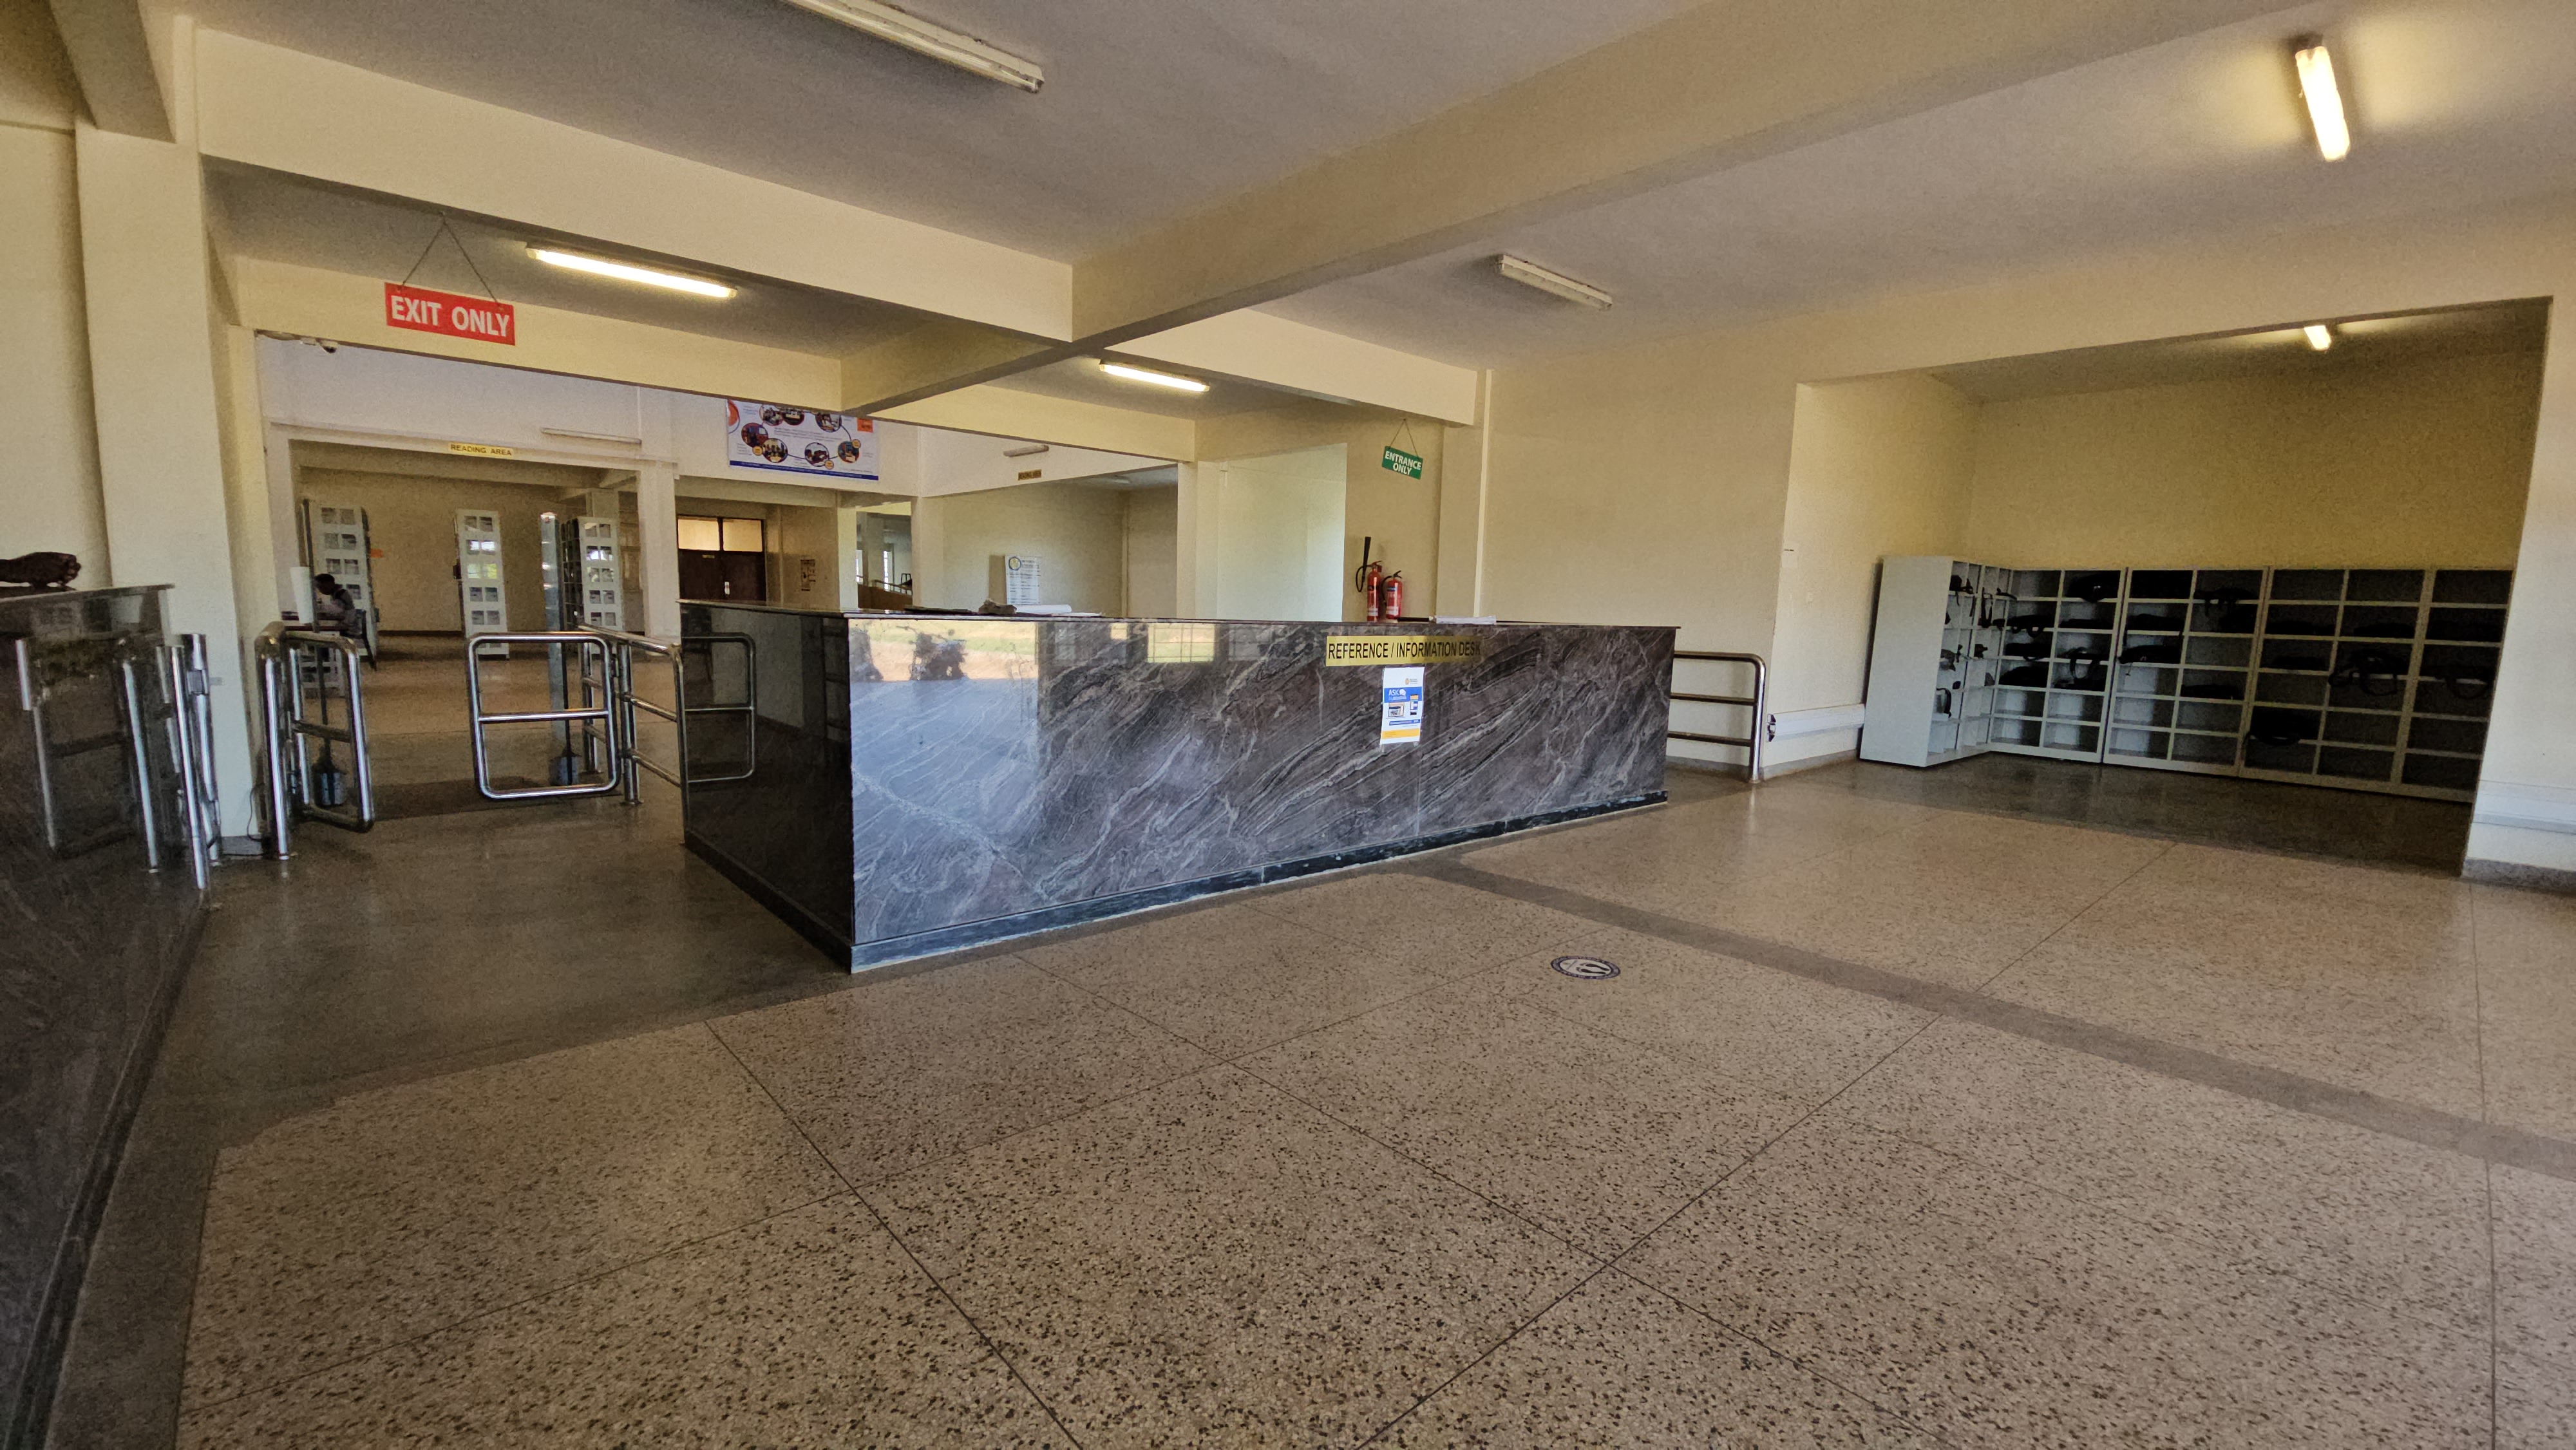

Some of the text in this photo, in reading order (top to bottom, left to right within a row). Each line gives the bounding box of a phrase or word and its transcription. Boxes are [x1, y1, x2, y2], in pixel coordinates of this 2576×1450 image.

[391, 295, 509, 337] EXIT ONLY
[450, 444, 512, 456] READING AREA
[1385, 450, 1422, 470] ENTRANCE
[1392, 462, 1412, 475] ONLY
[1329, 641, 1481, 659] REFERENCE / INFORMATION DESK
